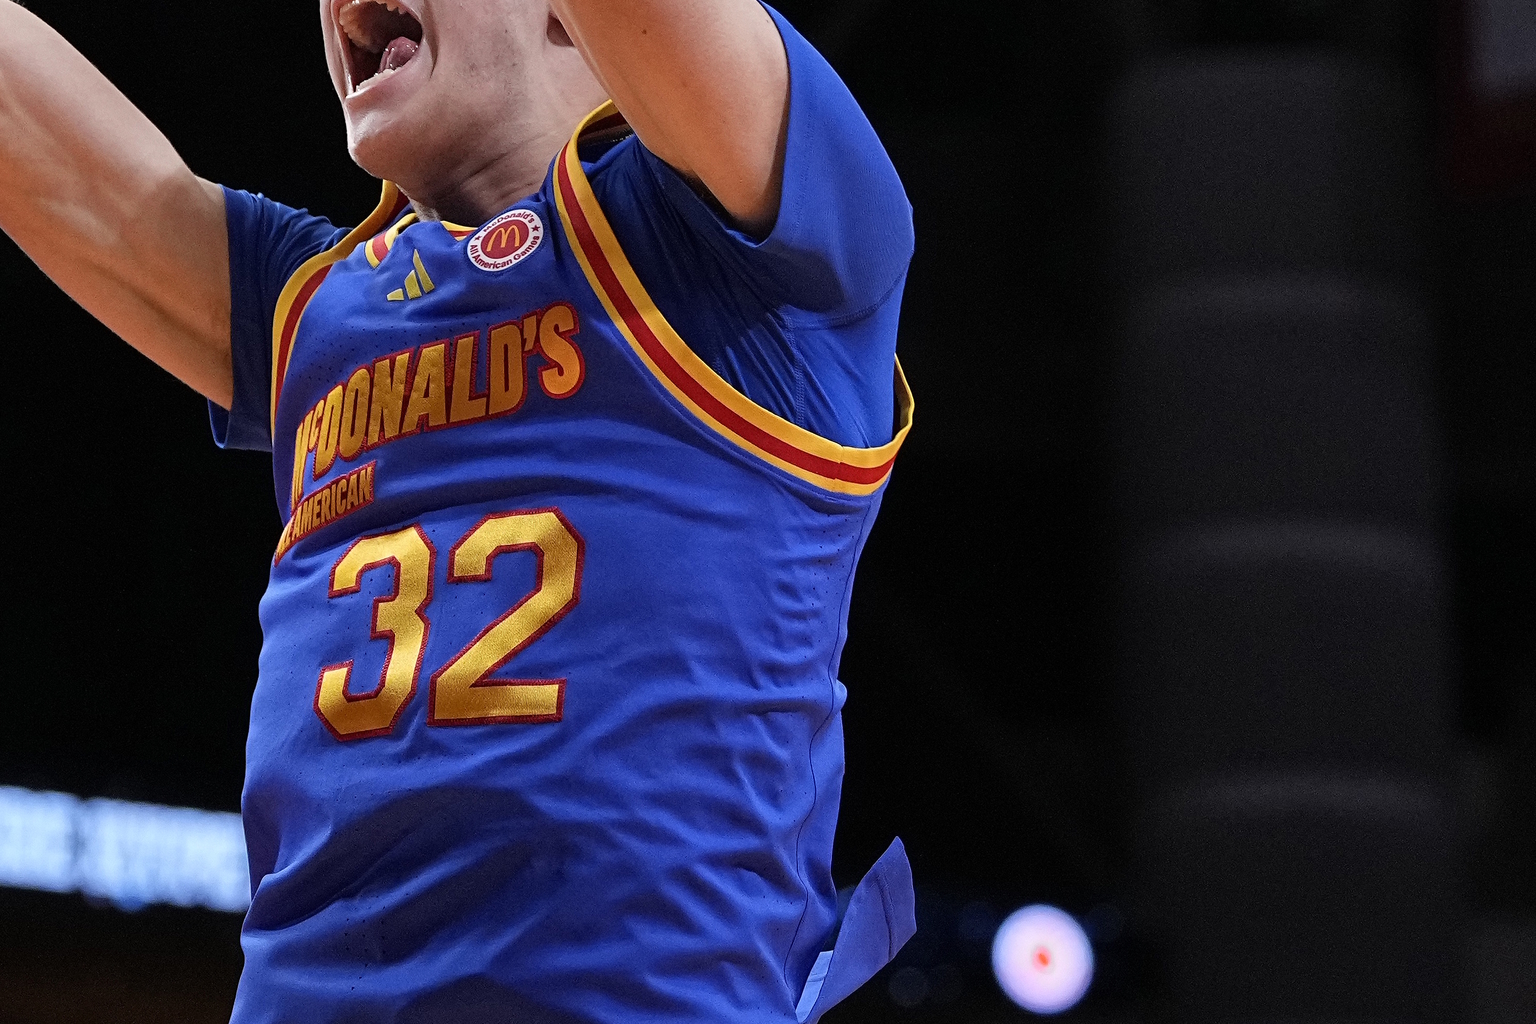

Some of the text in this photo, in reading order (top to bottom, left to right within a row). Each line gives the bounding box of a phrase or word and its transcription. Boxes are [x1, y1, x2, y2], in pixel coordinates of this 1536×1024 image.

[483, 211, 535, 233] McDonald's
[469, 235, 540, 269] All American Games
[291, 461, 375, 542] AMERICAN
[314, 507, 585, 743] 32
